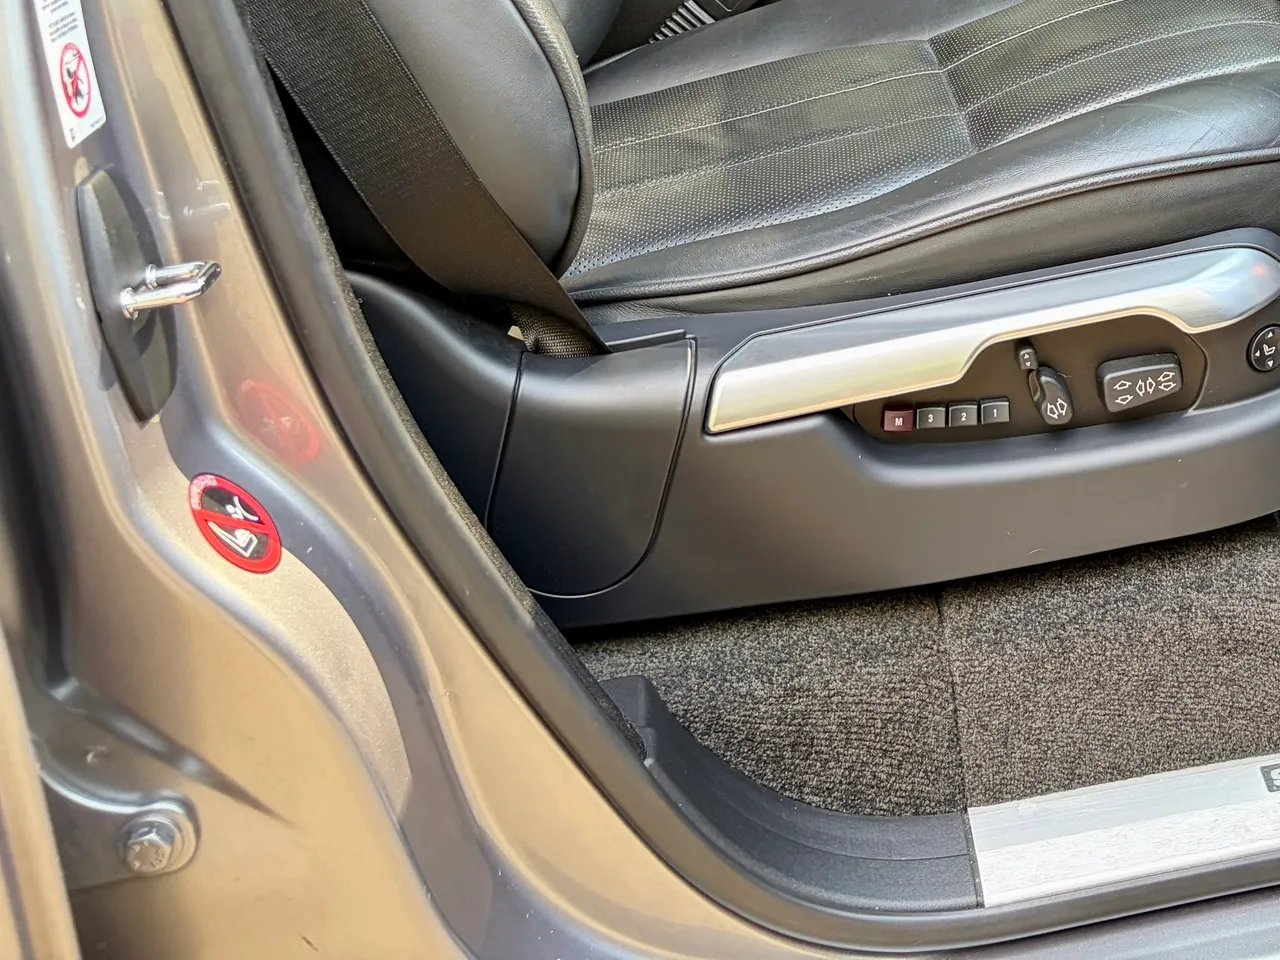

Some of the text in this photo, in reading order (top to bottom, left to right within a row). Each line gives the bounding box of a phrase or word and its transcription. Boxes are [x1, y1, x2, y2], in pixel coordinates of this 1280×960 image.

[894, 417, 903, 426] M
[927, 413, 934, 423] 3
[961, 412, 967, 421] 2
